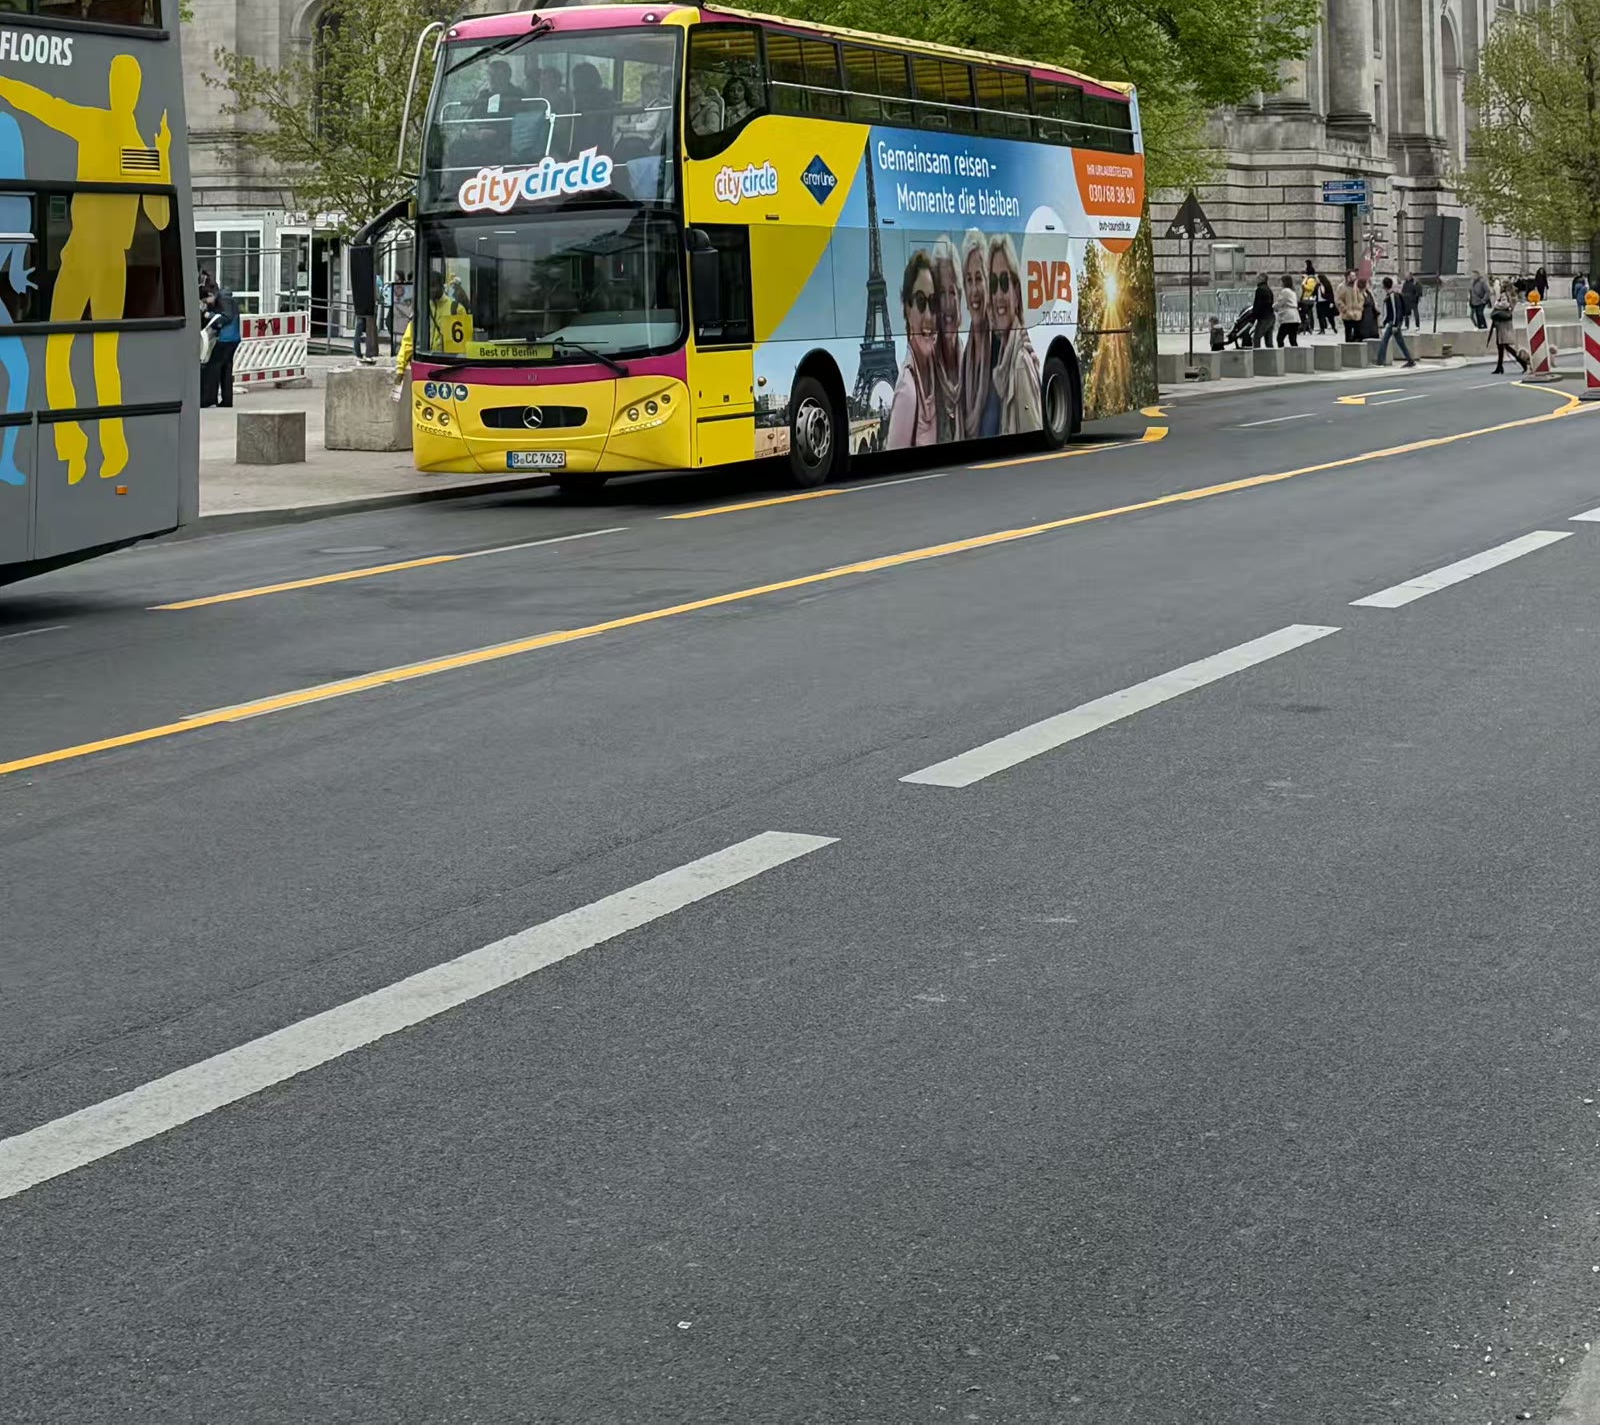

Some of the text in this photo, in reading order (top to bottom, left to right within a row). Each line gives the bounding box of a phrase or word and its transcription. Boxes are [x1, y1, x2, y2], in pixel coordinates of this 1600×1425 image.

[0, 31, 74, 67] FLOORS
[877, 141, 951, 174] Gemeinsam
[954, 149, 990, 178] reisen
[896, 183, 1020, 217] Momente die bleiben
[1027, 260, 1073, 310] BVB
[451, 321, 464, 344] 6
[479, 345, 538, 358] Best of Berlin
